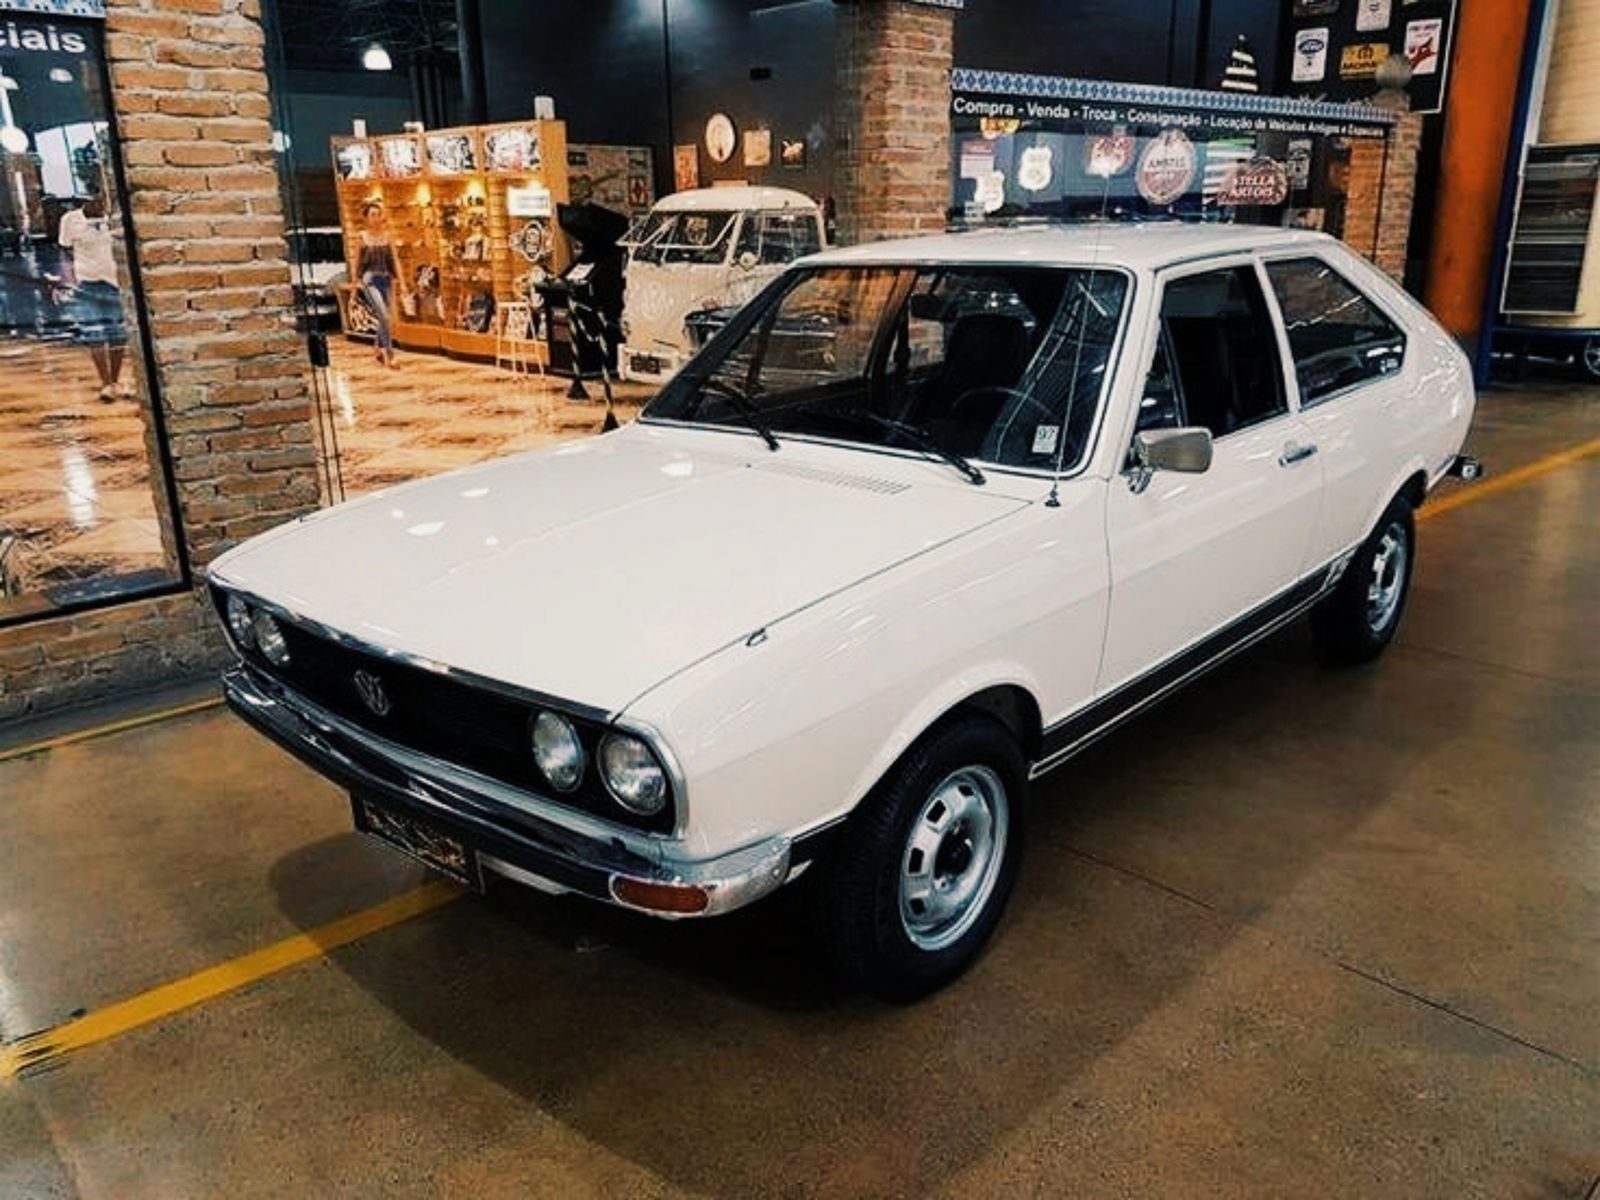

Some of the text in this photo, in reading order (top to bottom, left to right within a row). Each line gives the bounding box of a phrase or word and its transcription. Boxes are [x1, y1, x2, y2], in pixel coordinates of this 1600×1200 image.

[953, 97, 1015, 117] Compra
[1026, 102, 1070, 118] Venda
[1082, 105, 1117, 121] Troca
